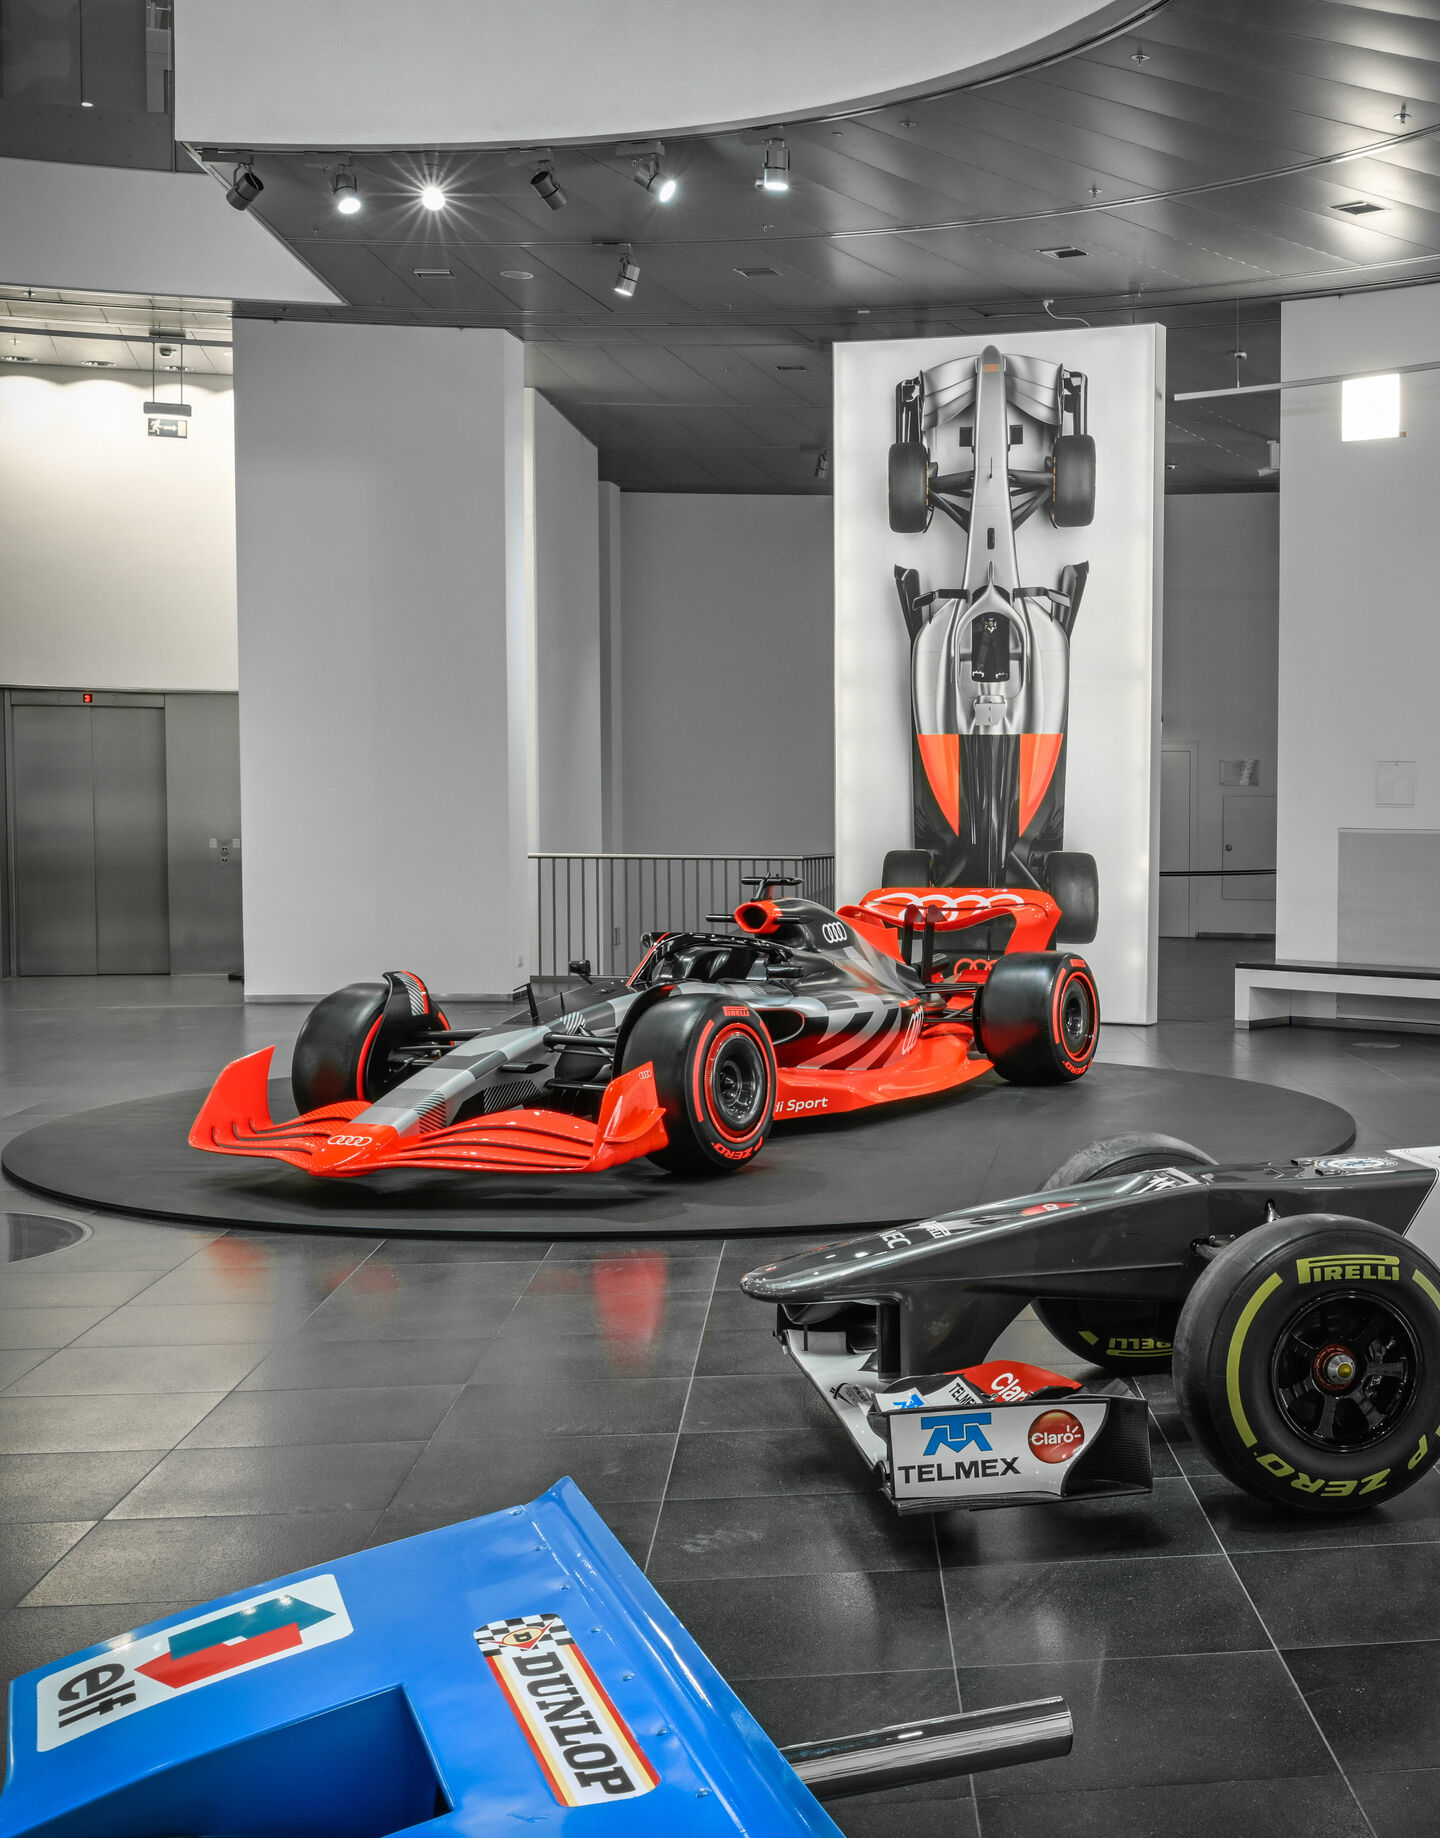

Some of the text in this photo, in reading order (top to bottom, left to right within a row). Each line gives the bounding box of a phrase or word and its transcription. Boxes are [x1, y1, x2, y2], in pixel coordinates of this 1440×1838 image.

[84, 695, 91, 703] 3
[786, 1097, 828, 1113] Sport
[711, 1142, 757, 1161] ZERO
[1296, 1253, 1401, 1285] PIRELLI
[1106, 1337, 1174, 1357] RELLI
[948, 1382, 978, 1405] TELME
[991, 1372, 1029, 1402] Clar
[1031, 1427, 1077, 1445] Claro
[897, 1456, 1021, 1484] TELMEX
[1255, 1434, 1428, 1497] P ZERO
[57, 1663, 137, 1729] elf
[511, 1651, 636, 1795] DUNLOP
